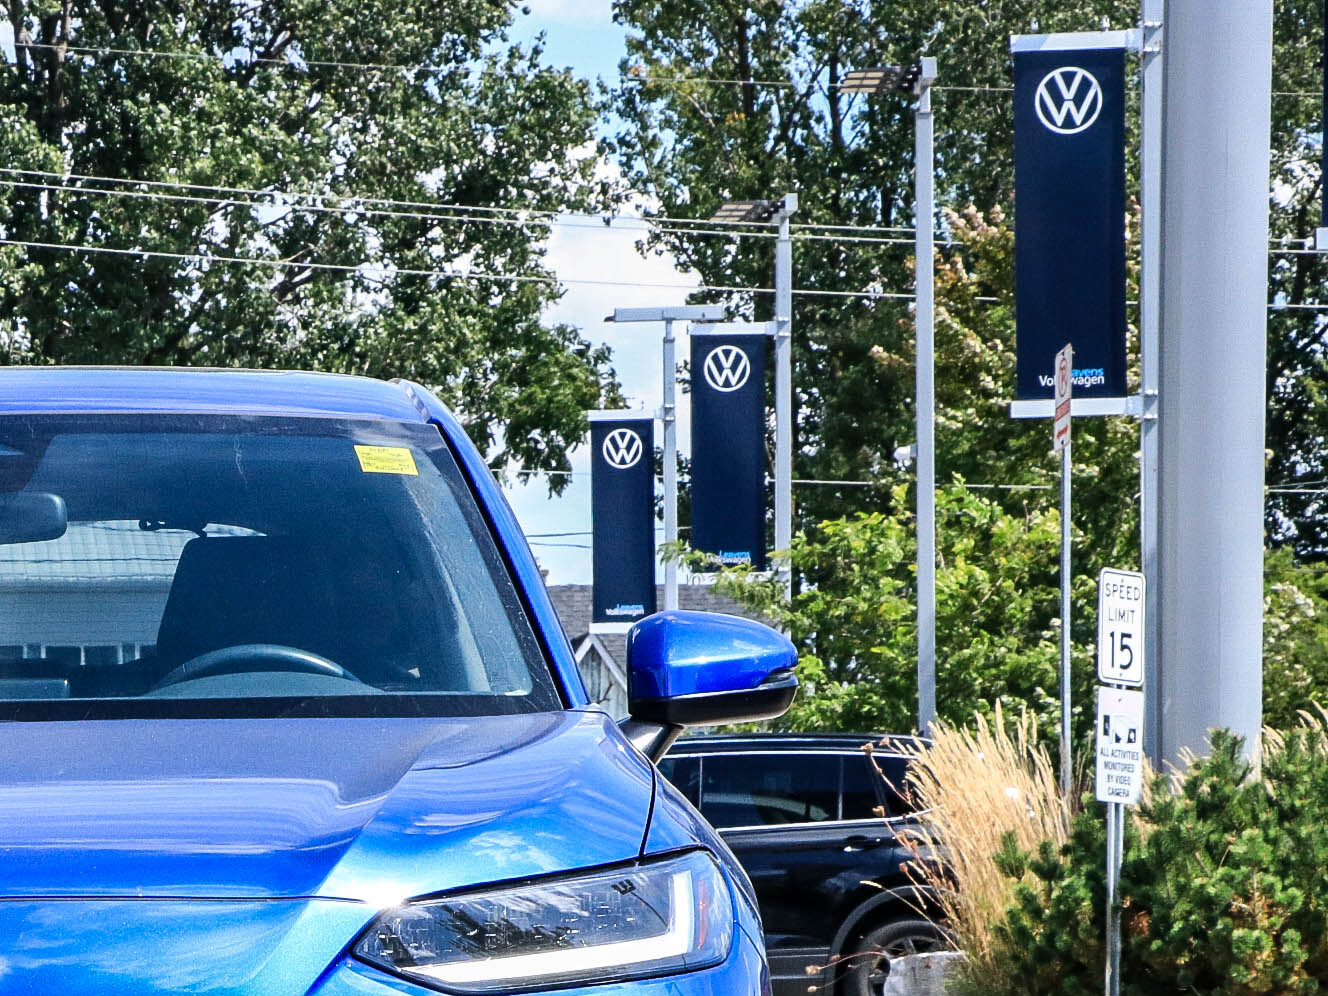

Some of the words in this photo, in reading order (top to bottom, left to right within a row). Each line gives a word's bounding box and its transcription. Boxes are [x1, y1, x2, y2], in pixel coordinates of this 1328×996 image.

[1105, 583, 1141, 601] SPEED
[1108, 608, 1135, 624] LIMIT
[1110, 631, 1134, 670] 15
[1100, 747, 1110, 757] ALL
[1110, 749, 1140, 761] ACTIVITIES
[1103, 761, 1135, 773] MONITORED
